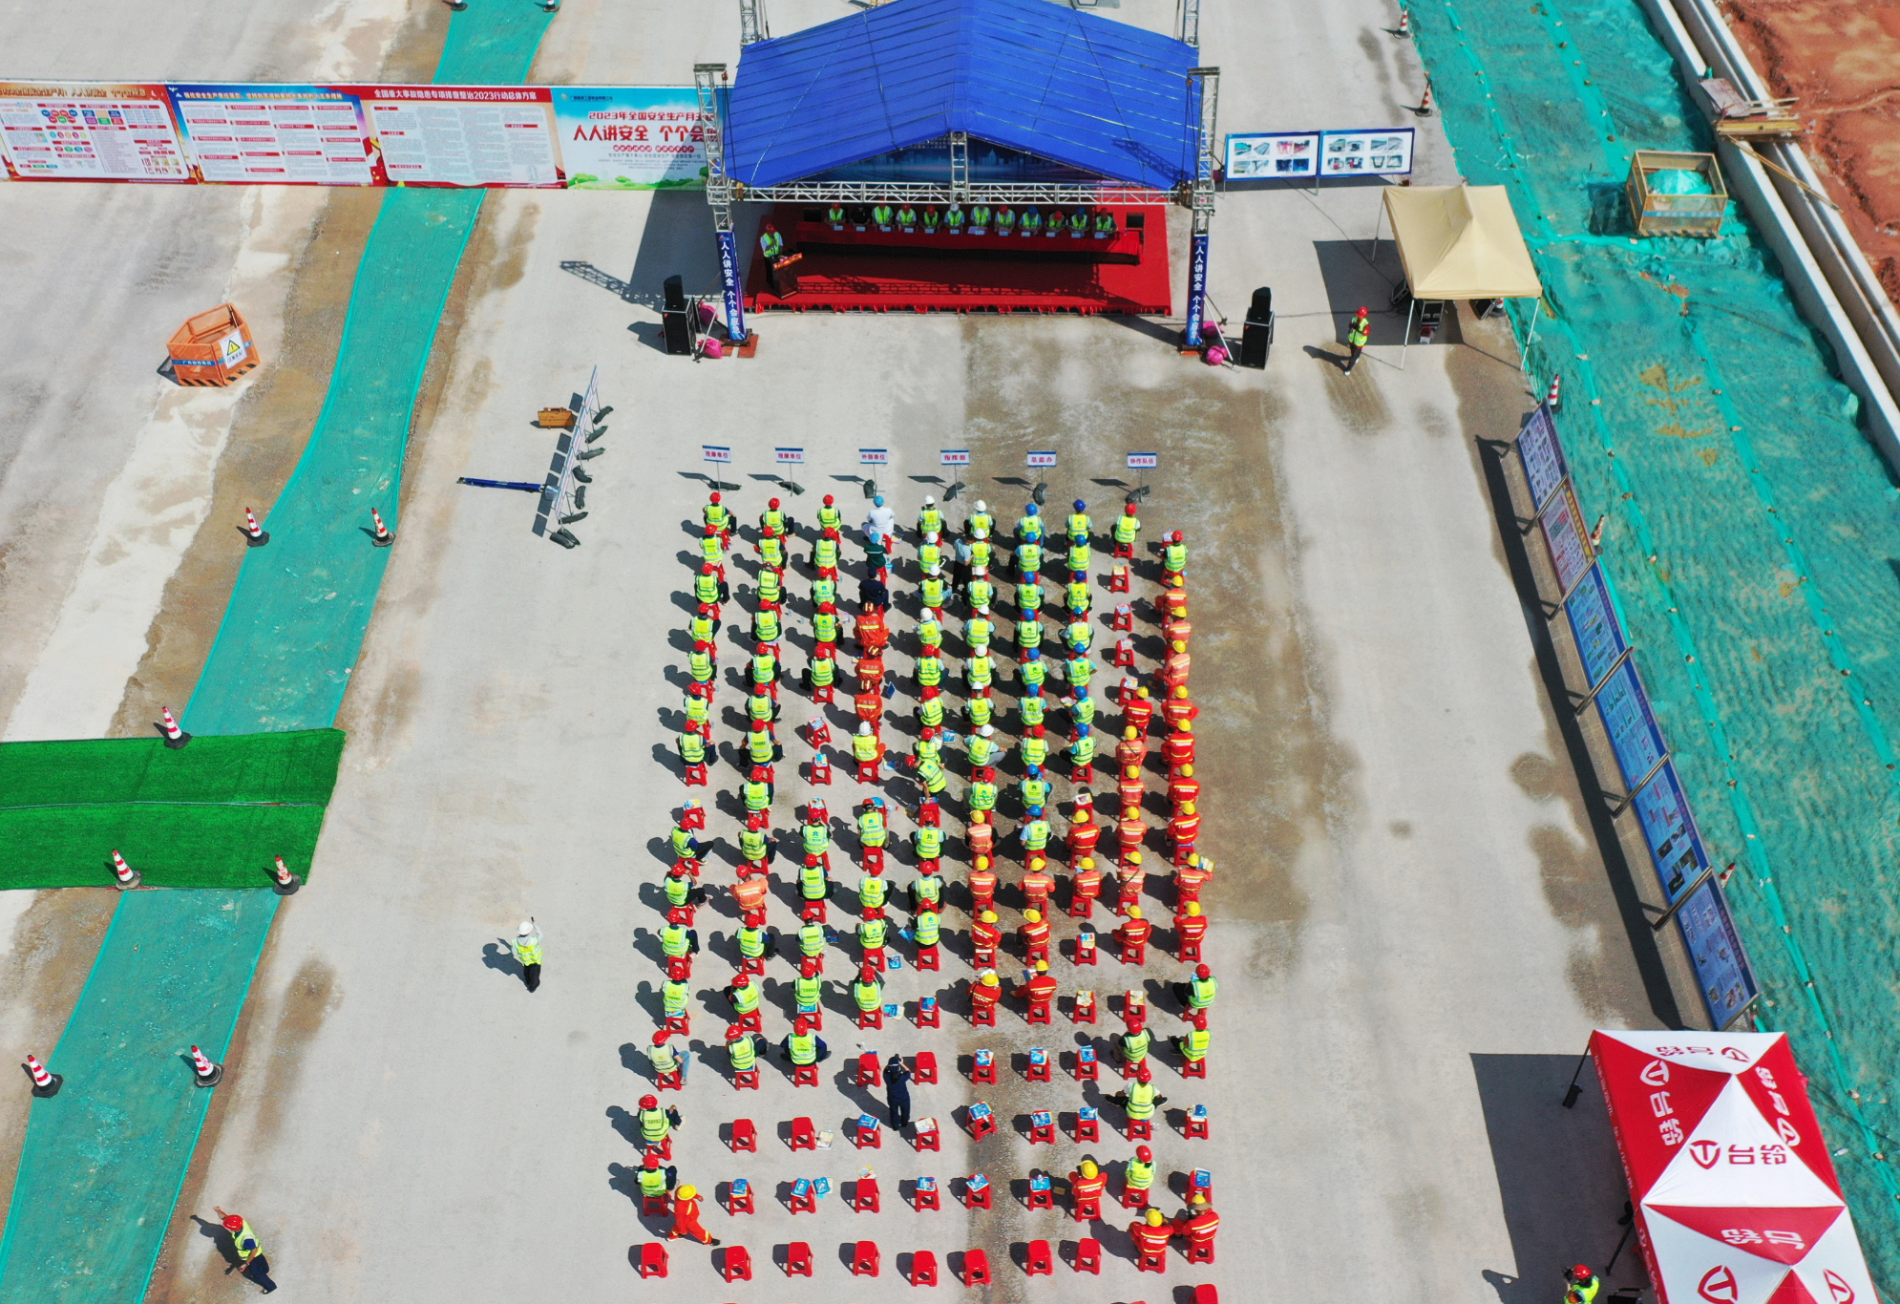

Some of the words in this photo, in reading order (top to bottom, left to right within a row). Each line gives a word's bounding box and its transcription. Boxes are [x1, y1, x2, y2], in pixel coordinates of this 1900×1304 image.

[573, 124, 649, 141] 人人讲安全
[721, 242, 734, 286] 人人讲安全
[1193, 246, 1204, 291] 人人讲安全
[1650, 1091, 1685, 1146] 台铃
[1728, 1144, 1787, 1165] 台铃
